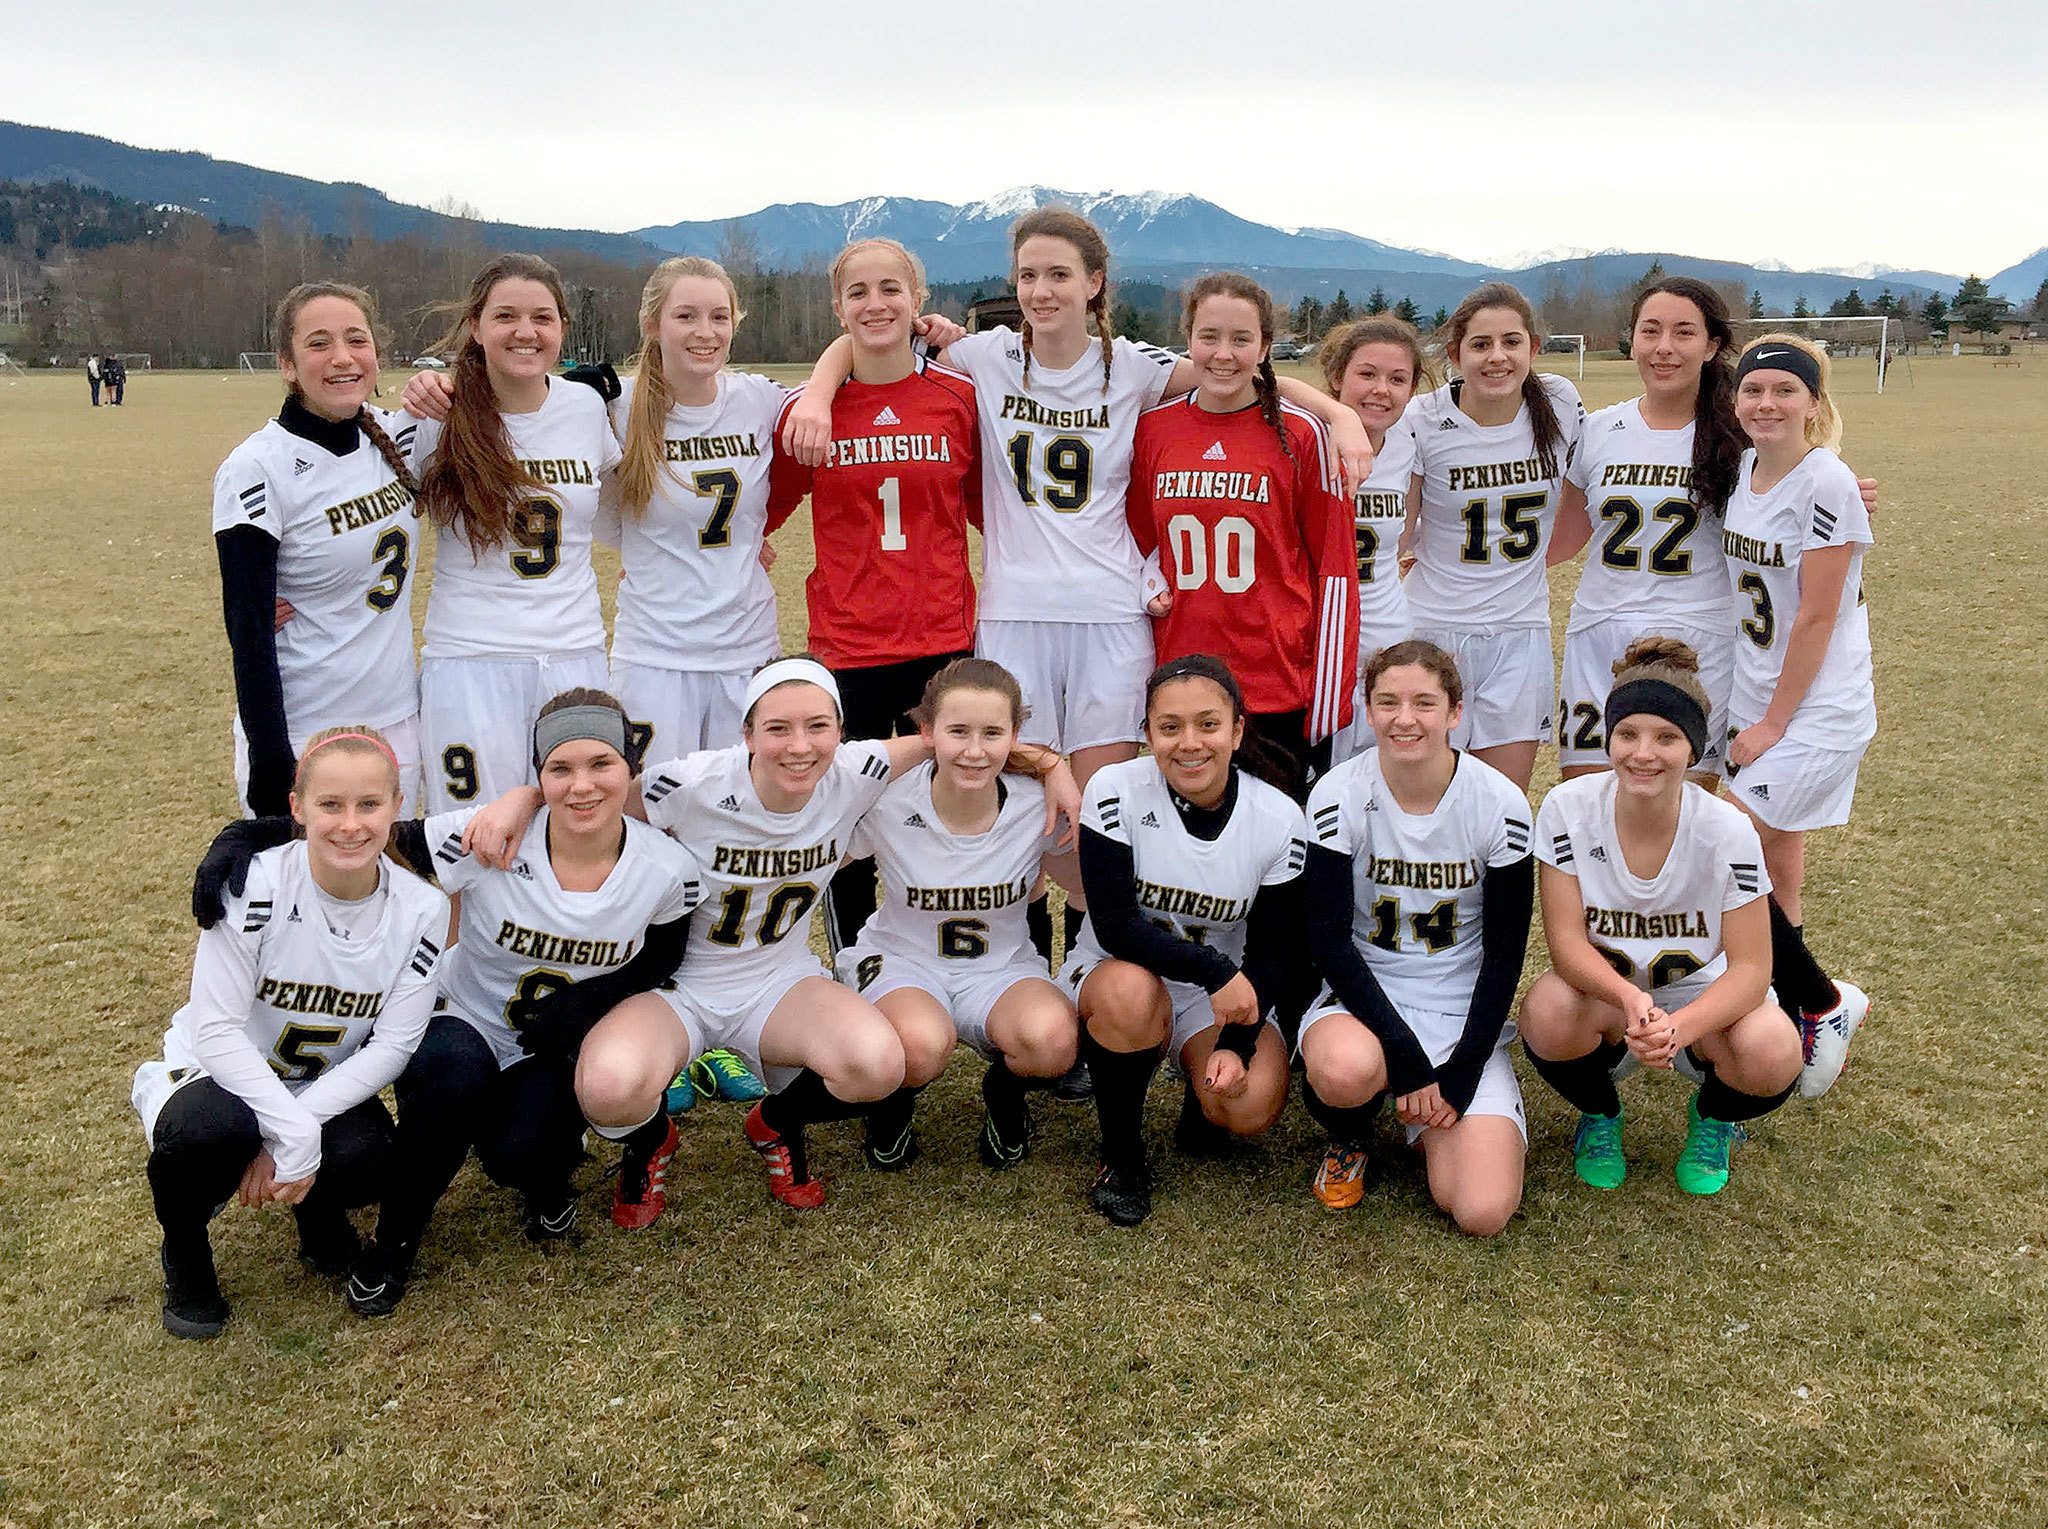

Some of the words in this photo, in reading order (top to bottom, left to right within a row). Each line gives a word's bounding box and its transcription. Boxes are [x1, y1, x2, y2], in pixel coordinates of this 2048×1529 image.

[1000, 394, 1110, 428] PENINSULA
[519, 459, 593, 486] NSULA
[665, 433, 760, 462] ENINSULA
[825, 435, 950, 468] PENINSULA
[1007, 431, 1093, 513] 19
[1601, 463, 1692, 488] PENINSU
[325, 478, 414, 536] PENINSU
[691, 467, 742, 549] 7
[878, 477, 906, 550] 1
[1155, 470, 1270, 504] PENINSULA
[509, 496, 562, 579] 9
[1167, 514, 1256, 593] 00
[1461, 492, 1548, 565] 15
[1601, 495, 1700, 576] 22
[1722, 528, 1786, 568] NINSULA
[366, 525, 409, 613] 3
[1738, 571, 1774, 650] 3
[441, 744, 481, 801] 9
[712, 839, 838, 877] PENINSULA
[706, 882, 820, 947] 10
[906, 876, 1027, 911] PENINSULA
[1585, 905, 1709, 939] PENINSULA
[495, 920, 633, 967] PENINSULA
[937, 917, 990, 959] 6
[1369, 896, 1461, 953] 14
[256, 977, 384, 1019] PENINSUL
[266, 1022, 347, 1081] 5
